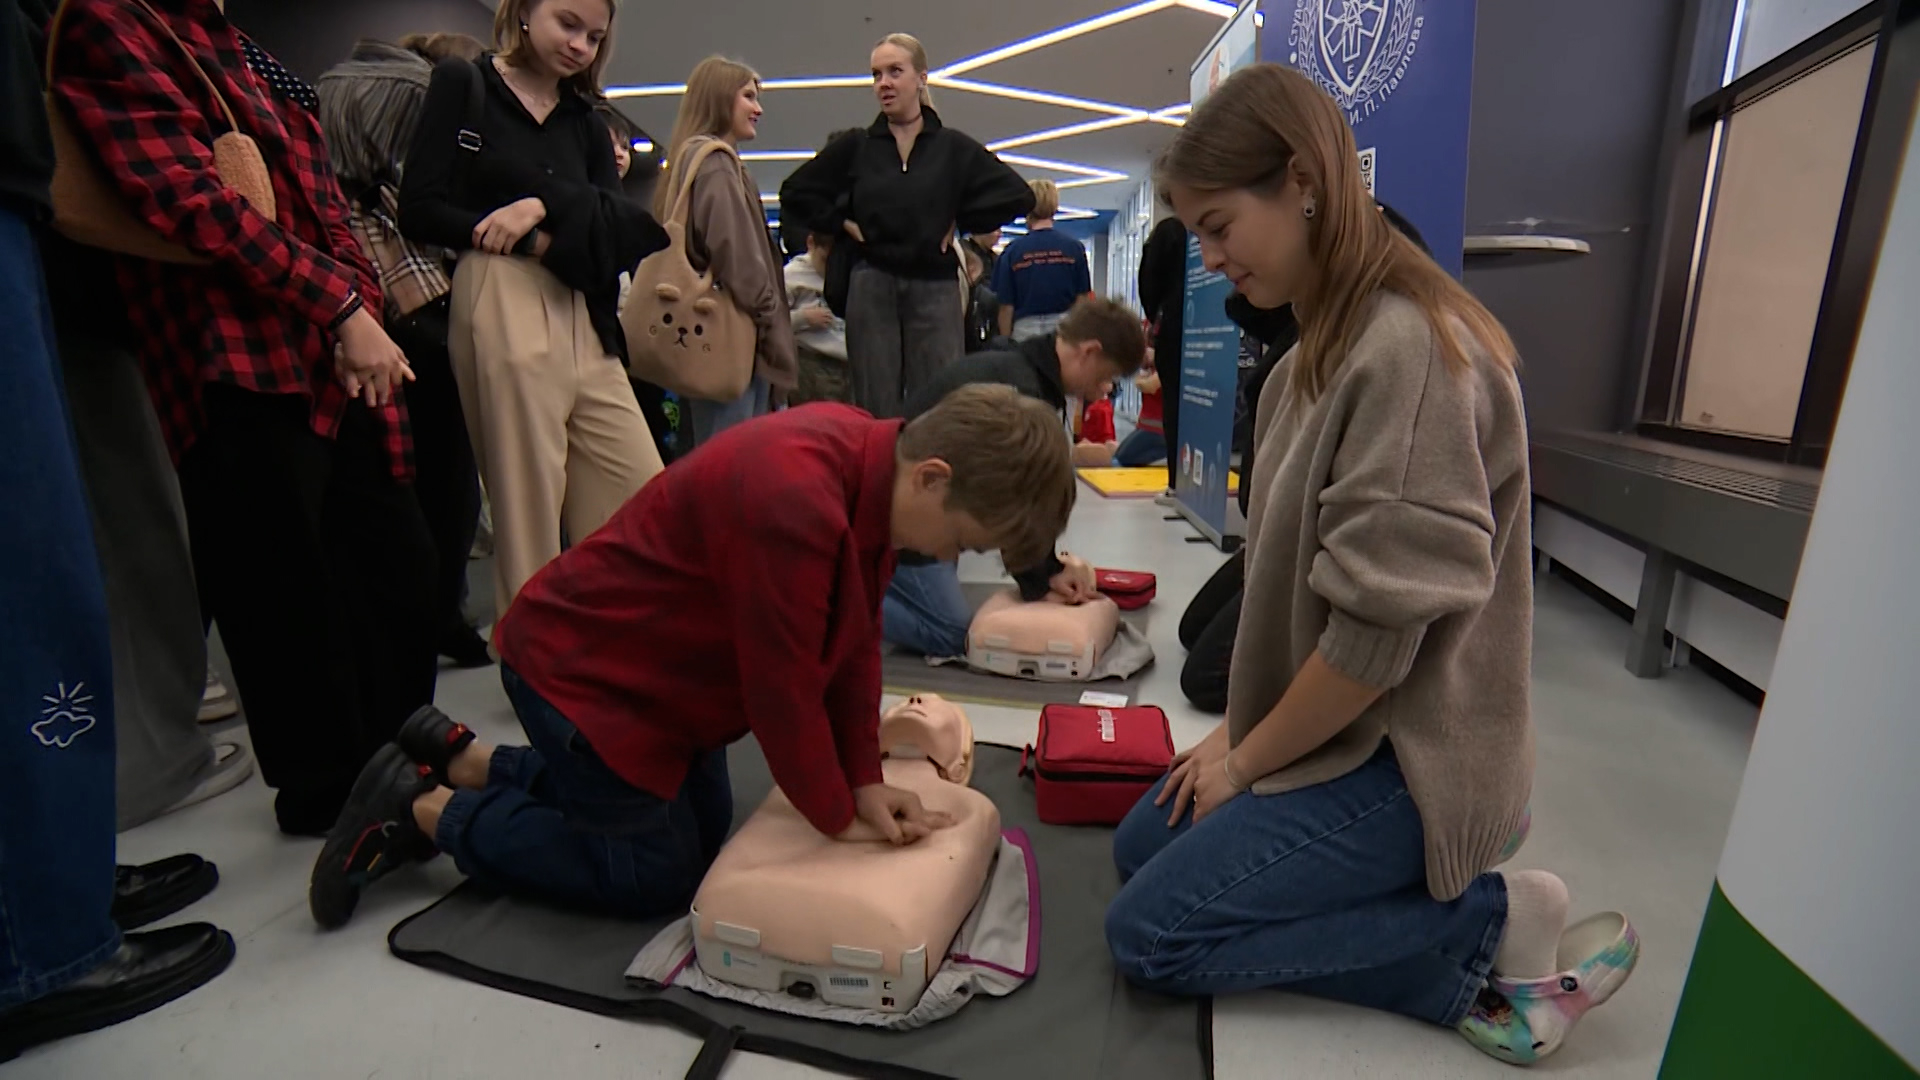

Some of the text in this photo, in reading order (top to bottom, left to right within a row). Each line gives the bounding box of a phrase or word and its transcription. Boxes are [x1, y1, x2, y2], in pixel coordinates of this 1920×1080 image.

[1350, 16, 1424, 126] И. П. Павлова
